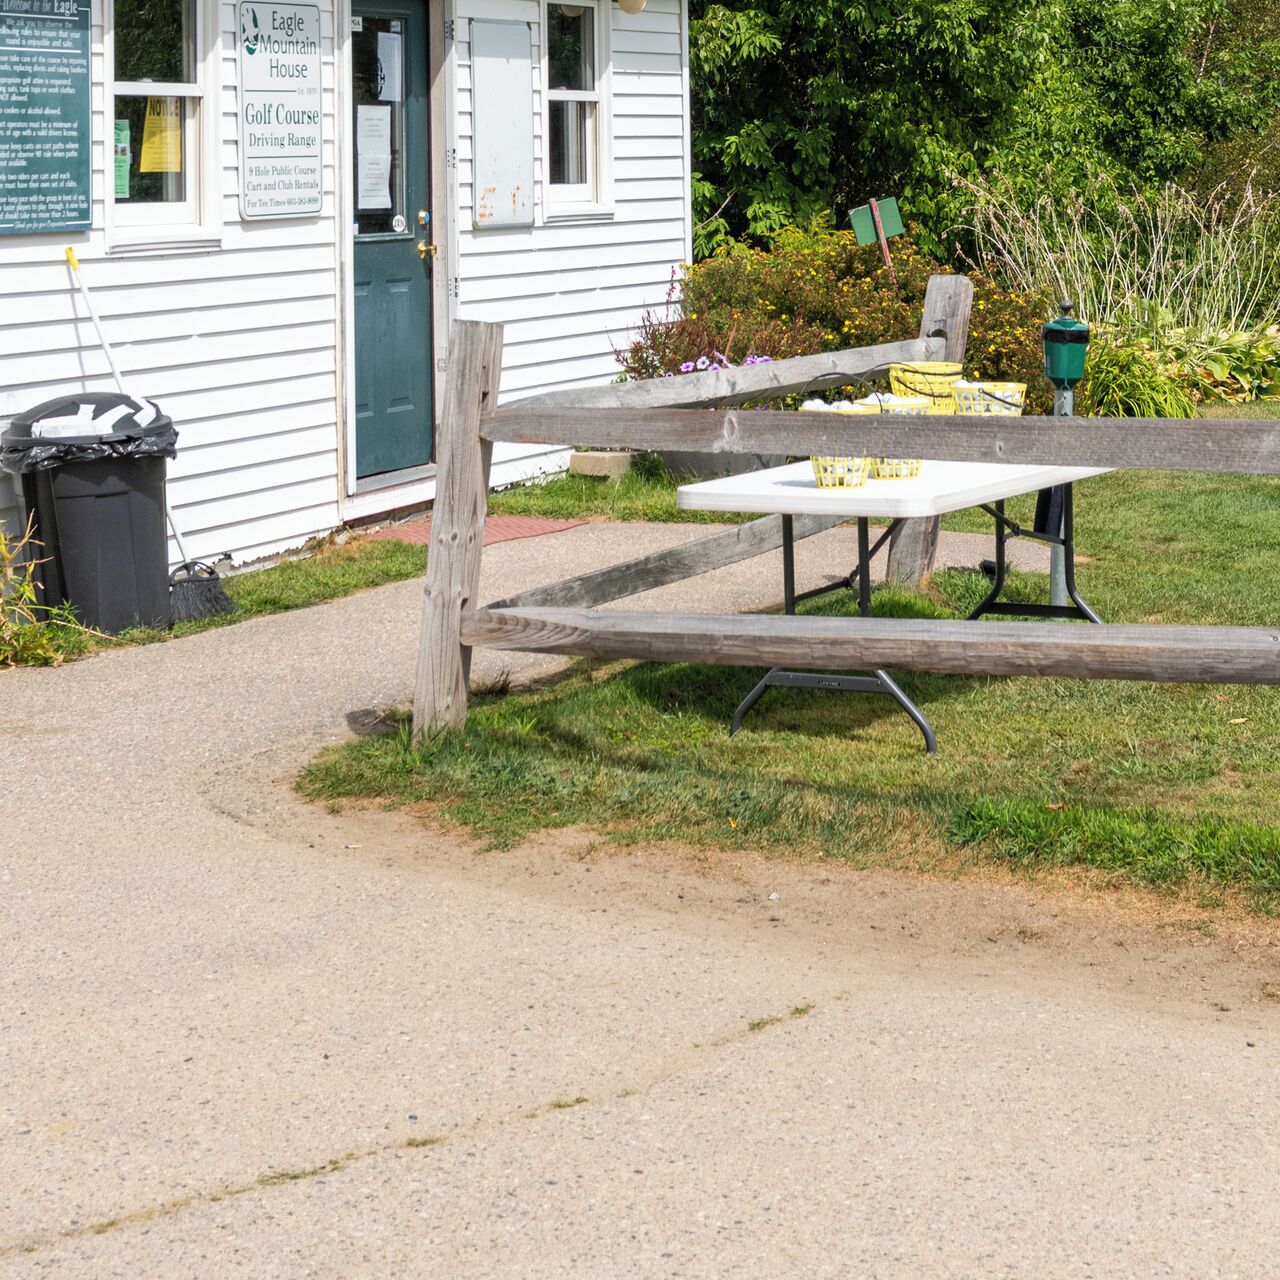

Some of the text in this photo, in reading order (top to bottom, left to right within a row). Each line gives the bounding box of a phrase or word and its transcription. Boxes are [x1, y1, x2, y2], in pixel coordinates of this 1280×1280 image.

[272, 11, 304, 37] Eagle
[260, 34, 317, 55] Mountain
[269, 58, 308, 78] House
[245, 102, 319, 125] Golf Course
[249, 132, 316, 149] Driving Range
[248, 165, 317, 176] 9 Hole Public Course
[247, 179, 319, 191] Cart and Club Rentals
[247, 199, 258, 208] For
[259, 198, 269, 208] Tee
[270, 198, 286, 207] Times
